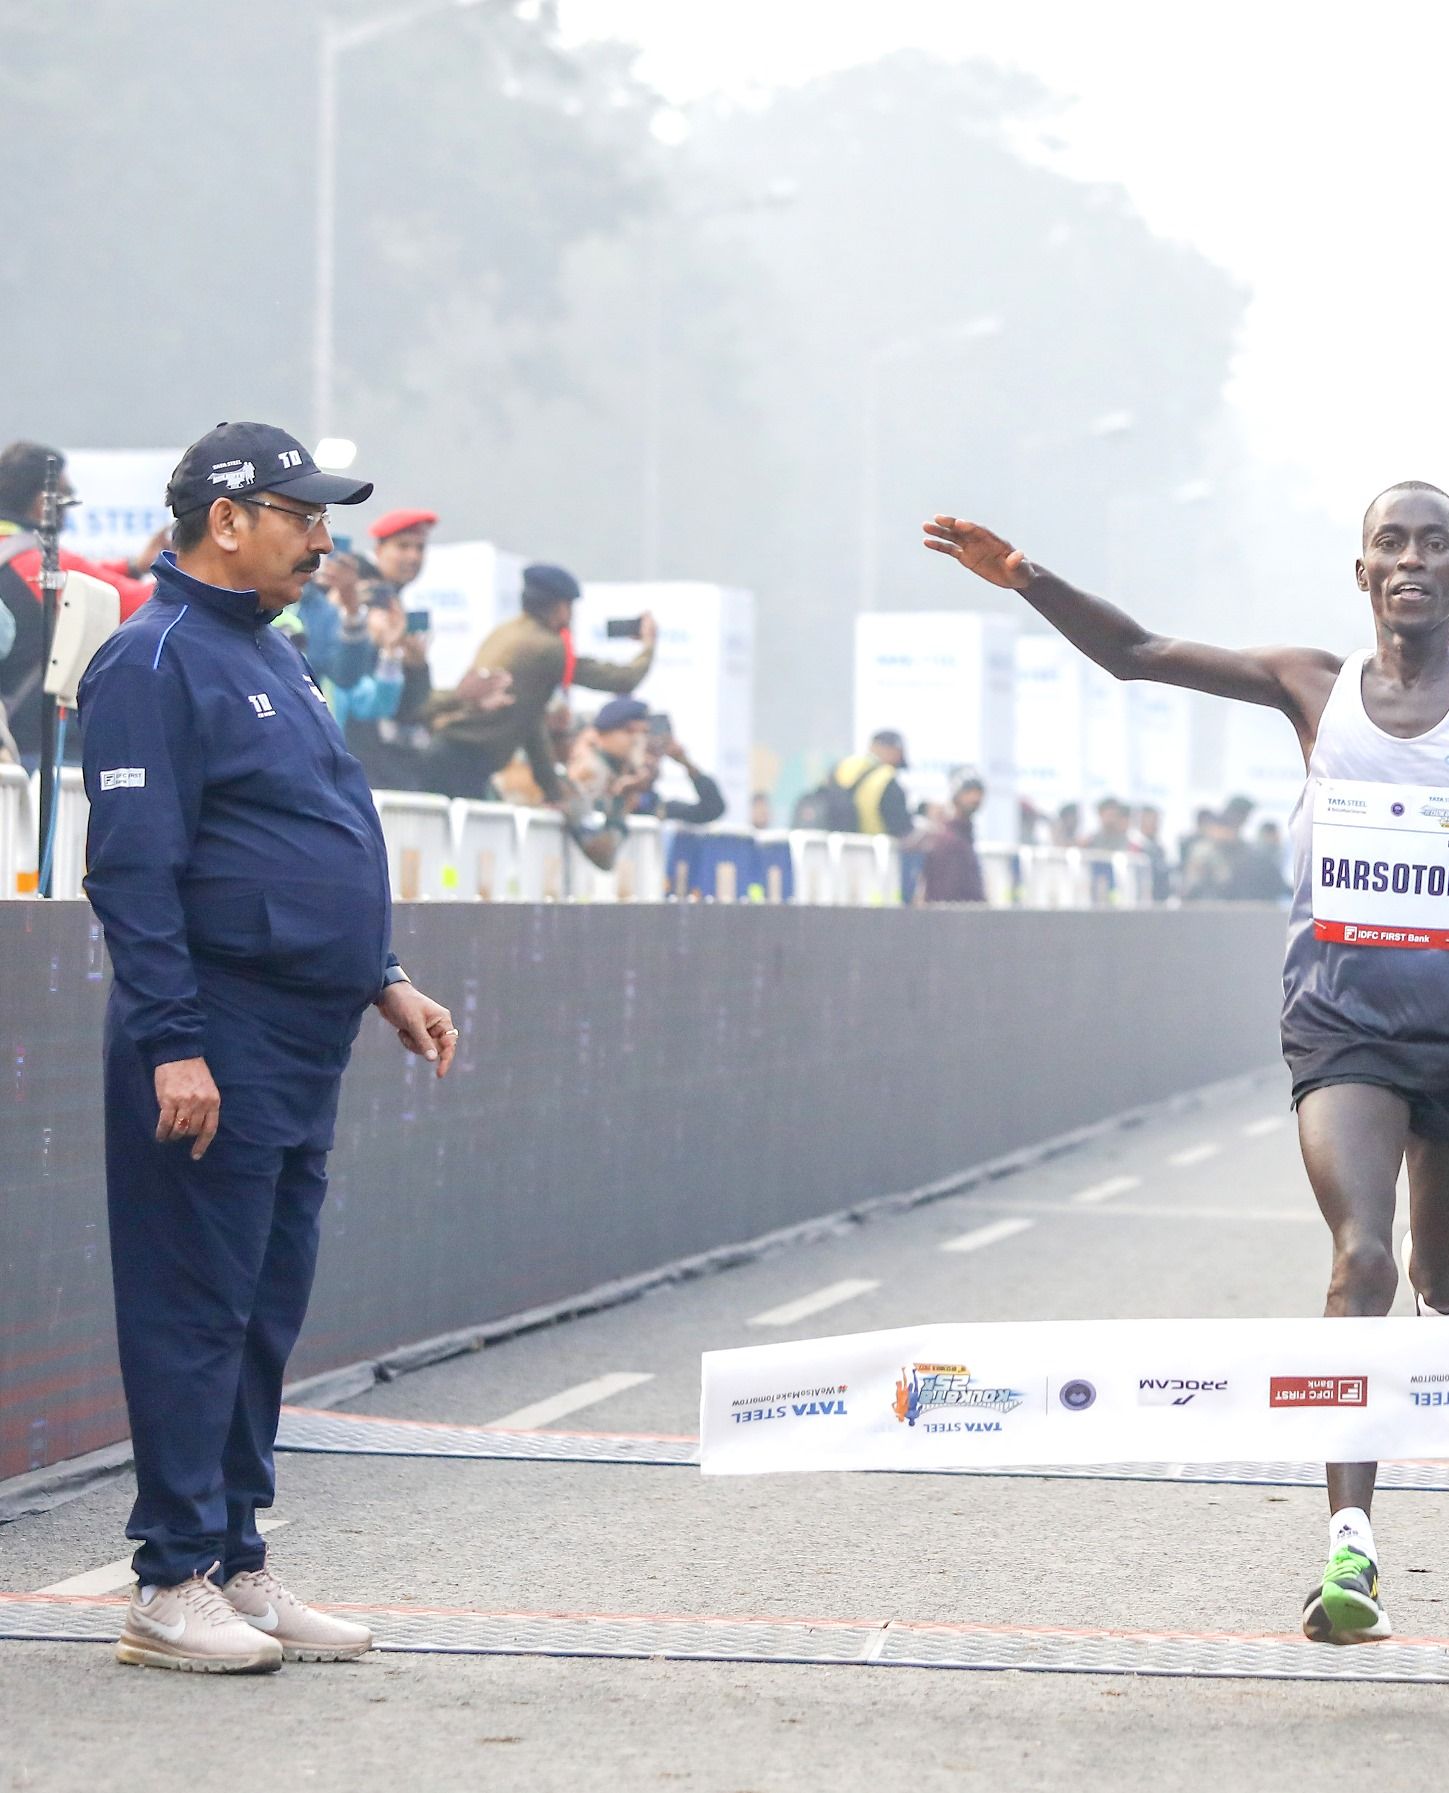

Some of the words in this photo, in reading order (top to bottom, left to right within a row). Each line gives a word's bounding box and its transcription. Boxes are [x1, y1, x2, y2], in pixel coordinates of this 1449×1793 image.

[1328, 798, 1346, 806] TATA
[1347, 799, 1368, 807] STEEL
[1358, 930, 1379, 940] IDFC
[1380, 931, 1407, 942] FIRST
[1408, 934, 1430, 943] Bank
[1139, 1379, 1228, 1391] PROCAM
[1308, 1380, 1333, 1389] Bank
[1275, 1390, 1306, 1400] FIRST
[1309, 1390, 1333, 1399] IDFC
[792, 1400, 848, 1416] TATA
[731, 1406, 787, 1423] STEEL
[923, 1423, 961, 1433] STEEL
[964, 1422, 1002, 1432] TATA
